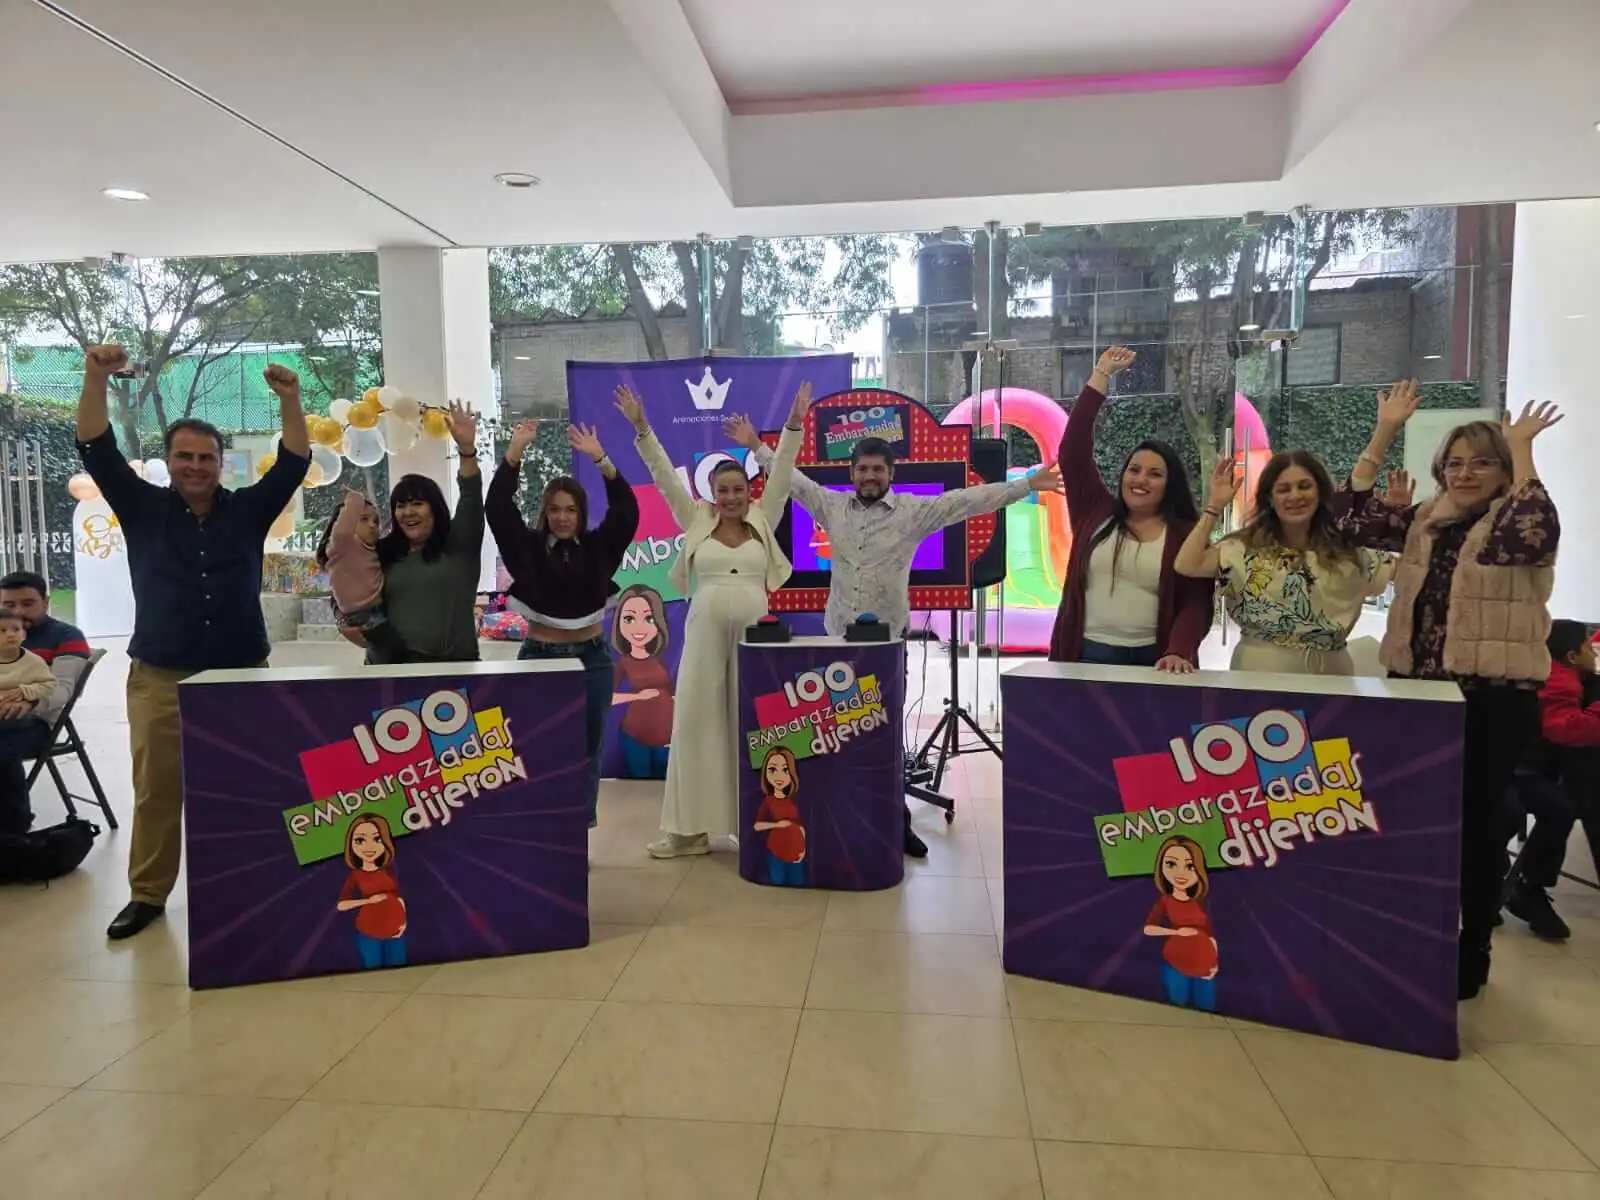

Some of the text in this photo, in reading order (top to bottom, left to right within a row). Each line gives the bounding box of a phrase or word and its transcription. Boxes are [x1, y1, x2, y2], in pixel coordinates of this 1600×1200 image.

[836, 406, 885, 426] 100
[783, 661, 855, 708] 100
[353, 690, 469, 764] 100
[1169, 709, 1306, 782] 100
